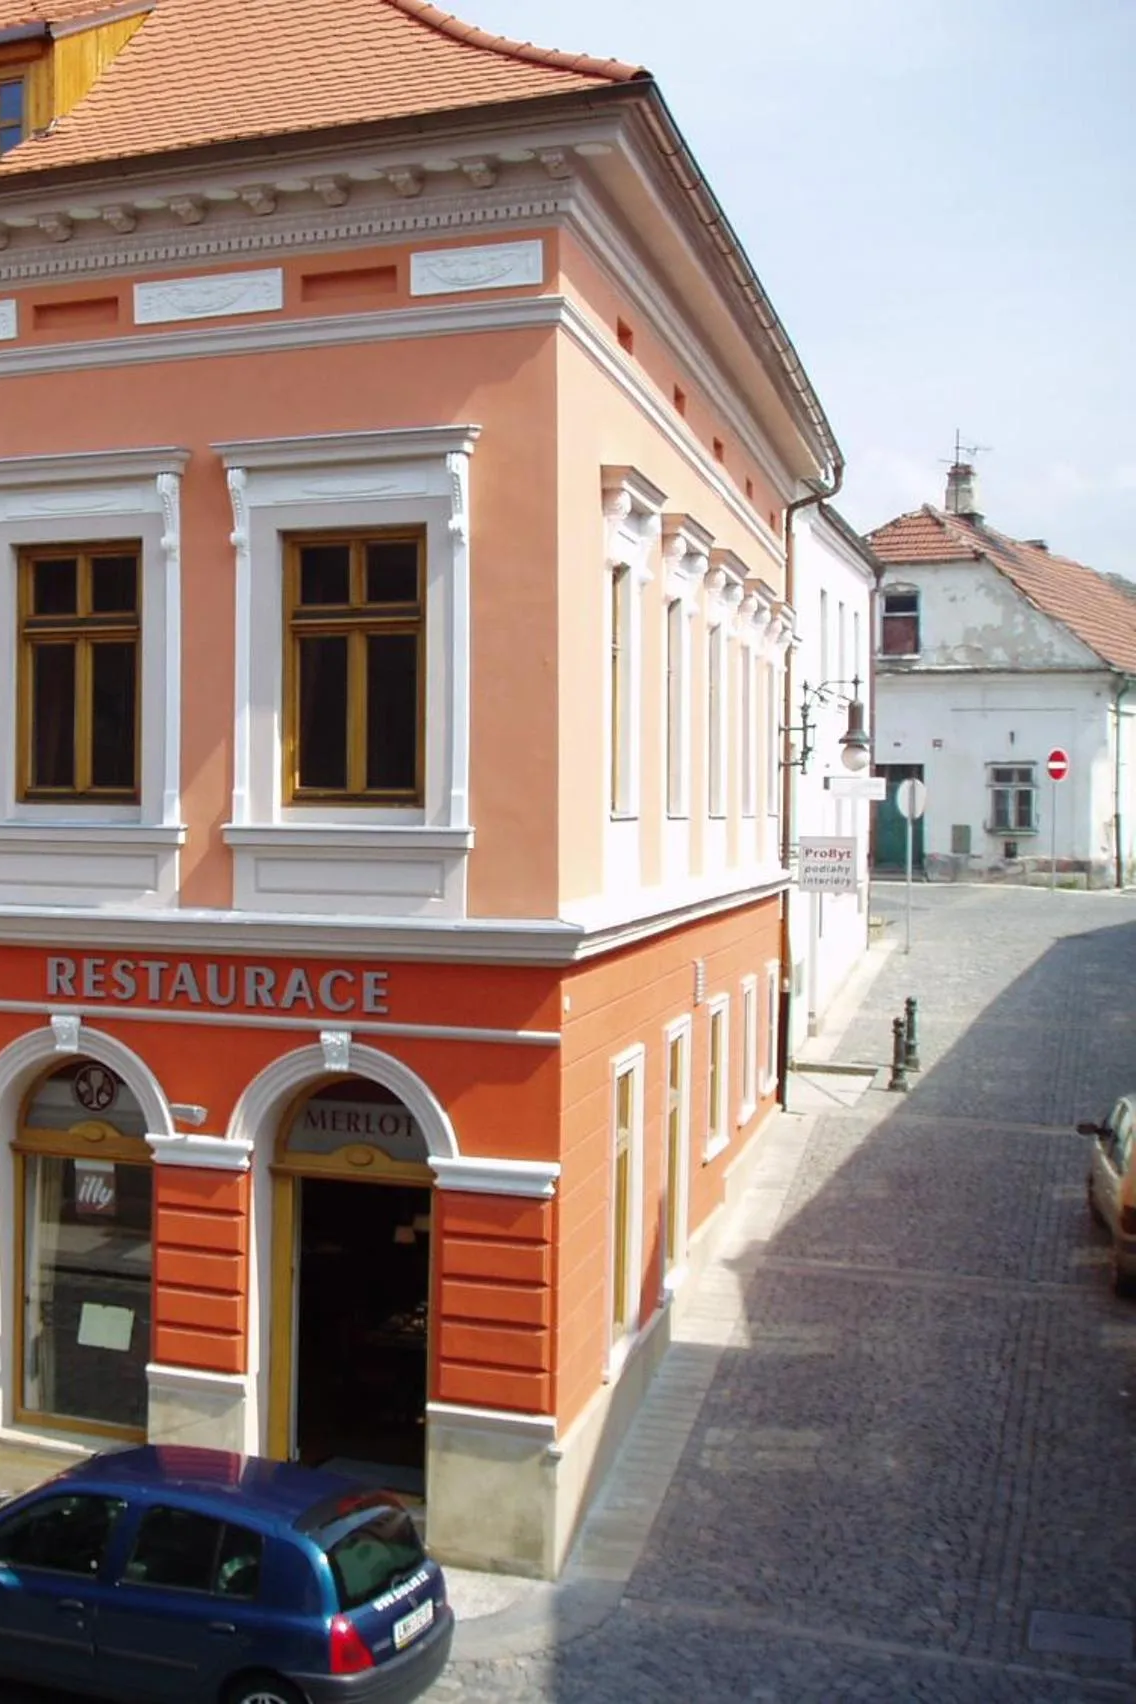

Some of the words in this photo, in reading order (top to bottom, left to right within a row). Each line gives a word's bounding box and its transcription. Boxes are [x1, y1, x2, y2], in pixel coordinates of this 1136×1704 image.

[46, 956, 389, 1014] RESTAURACE
[304, 1107, 414, 1137] MERLOT
[78, 1176, 113, 1211] illy
